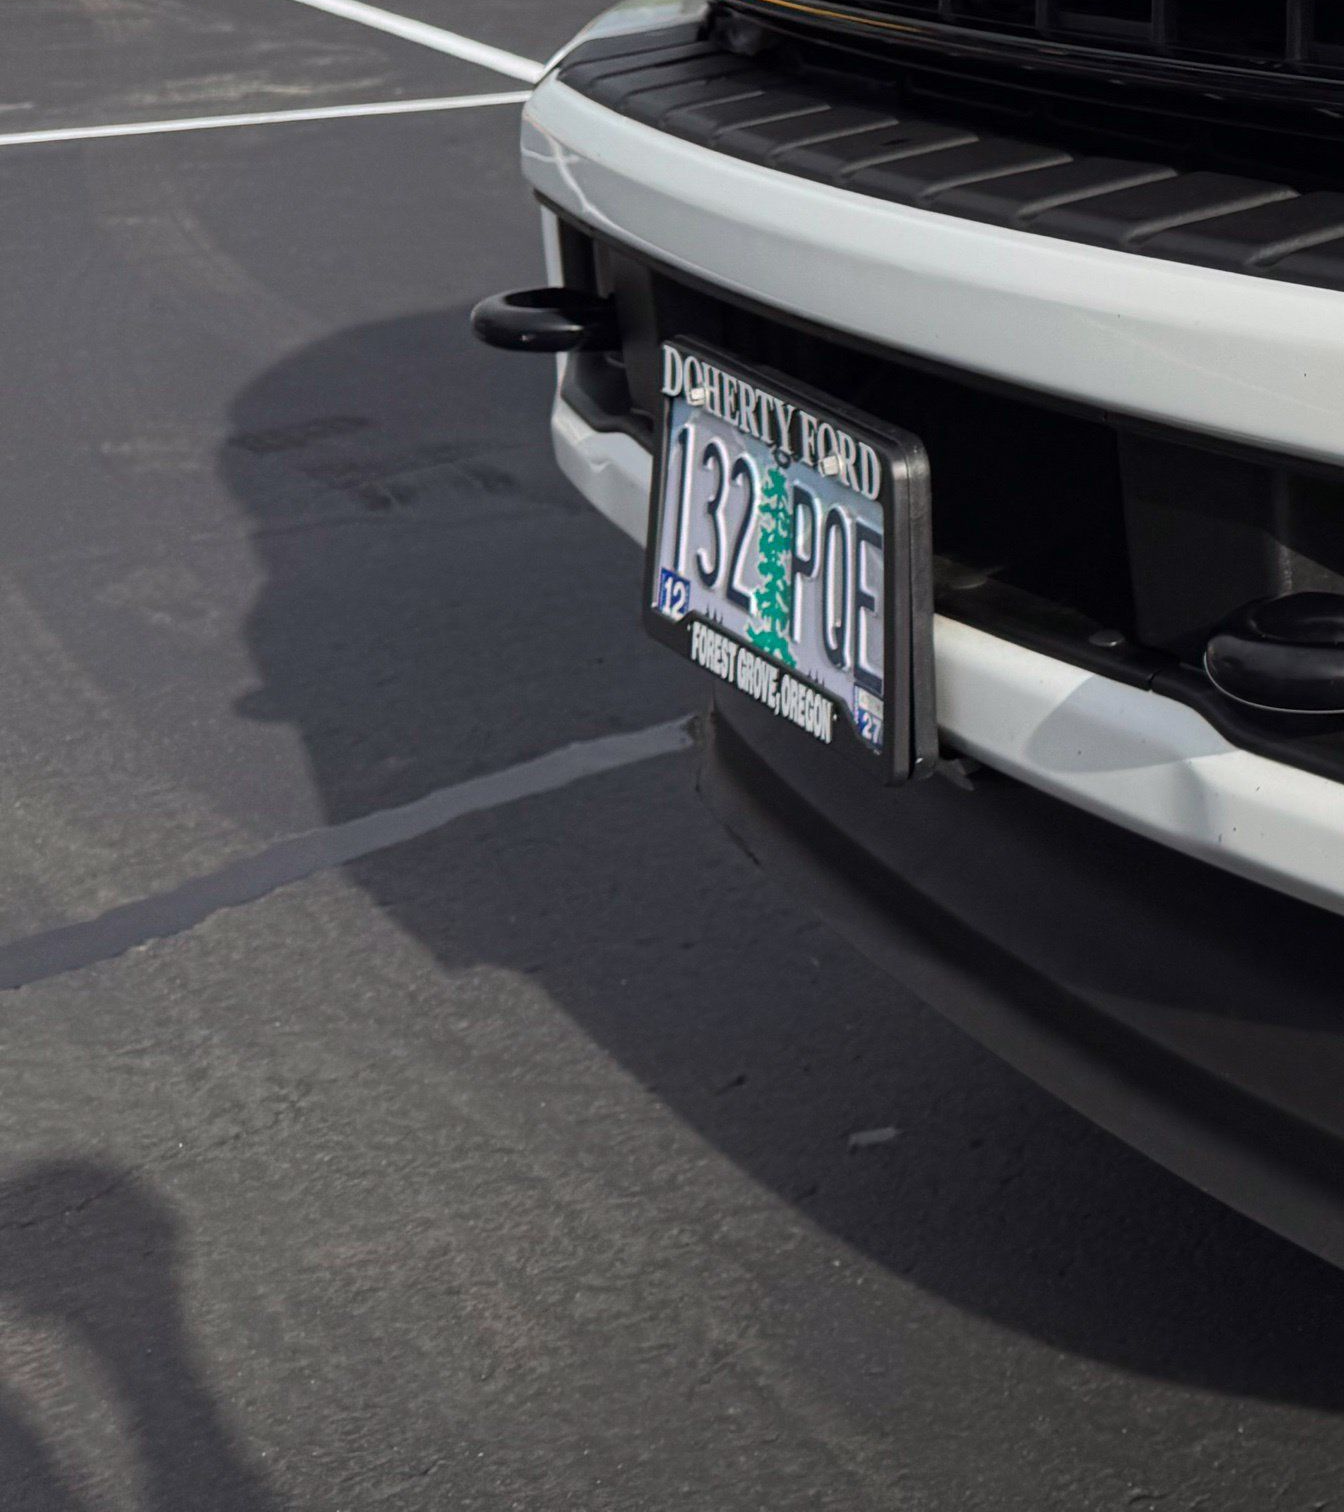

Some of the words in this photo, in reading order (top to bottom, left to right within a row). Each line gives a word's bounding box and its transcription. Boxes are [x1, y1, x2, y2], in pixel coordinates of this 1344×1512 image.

[661, 344, 795, 456] DOHERTY
[799, 409, 882, 501] FORD
[674, 422, 761, 615] 132
[663, 576, 687, 621] 12
[691, 620, 738, 683] FOREST
[736, 647, 782, 716] GROVE,
[781, 674, 834, 745] OREGON
[862, 711, 882, 744] 27
